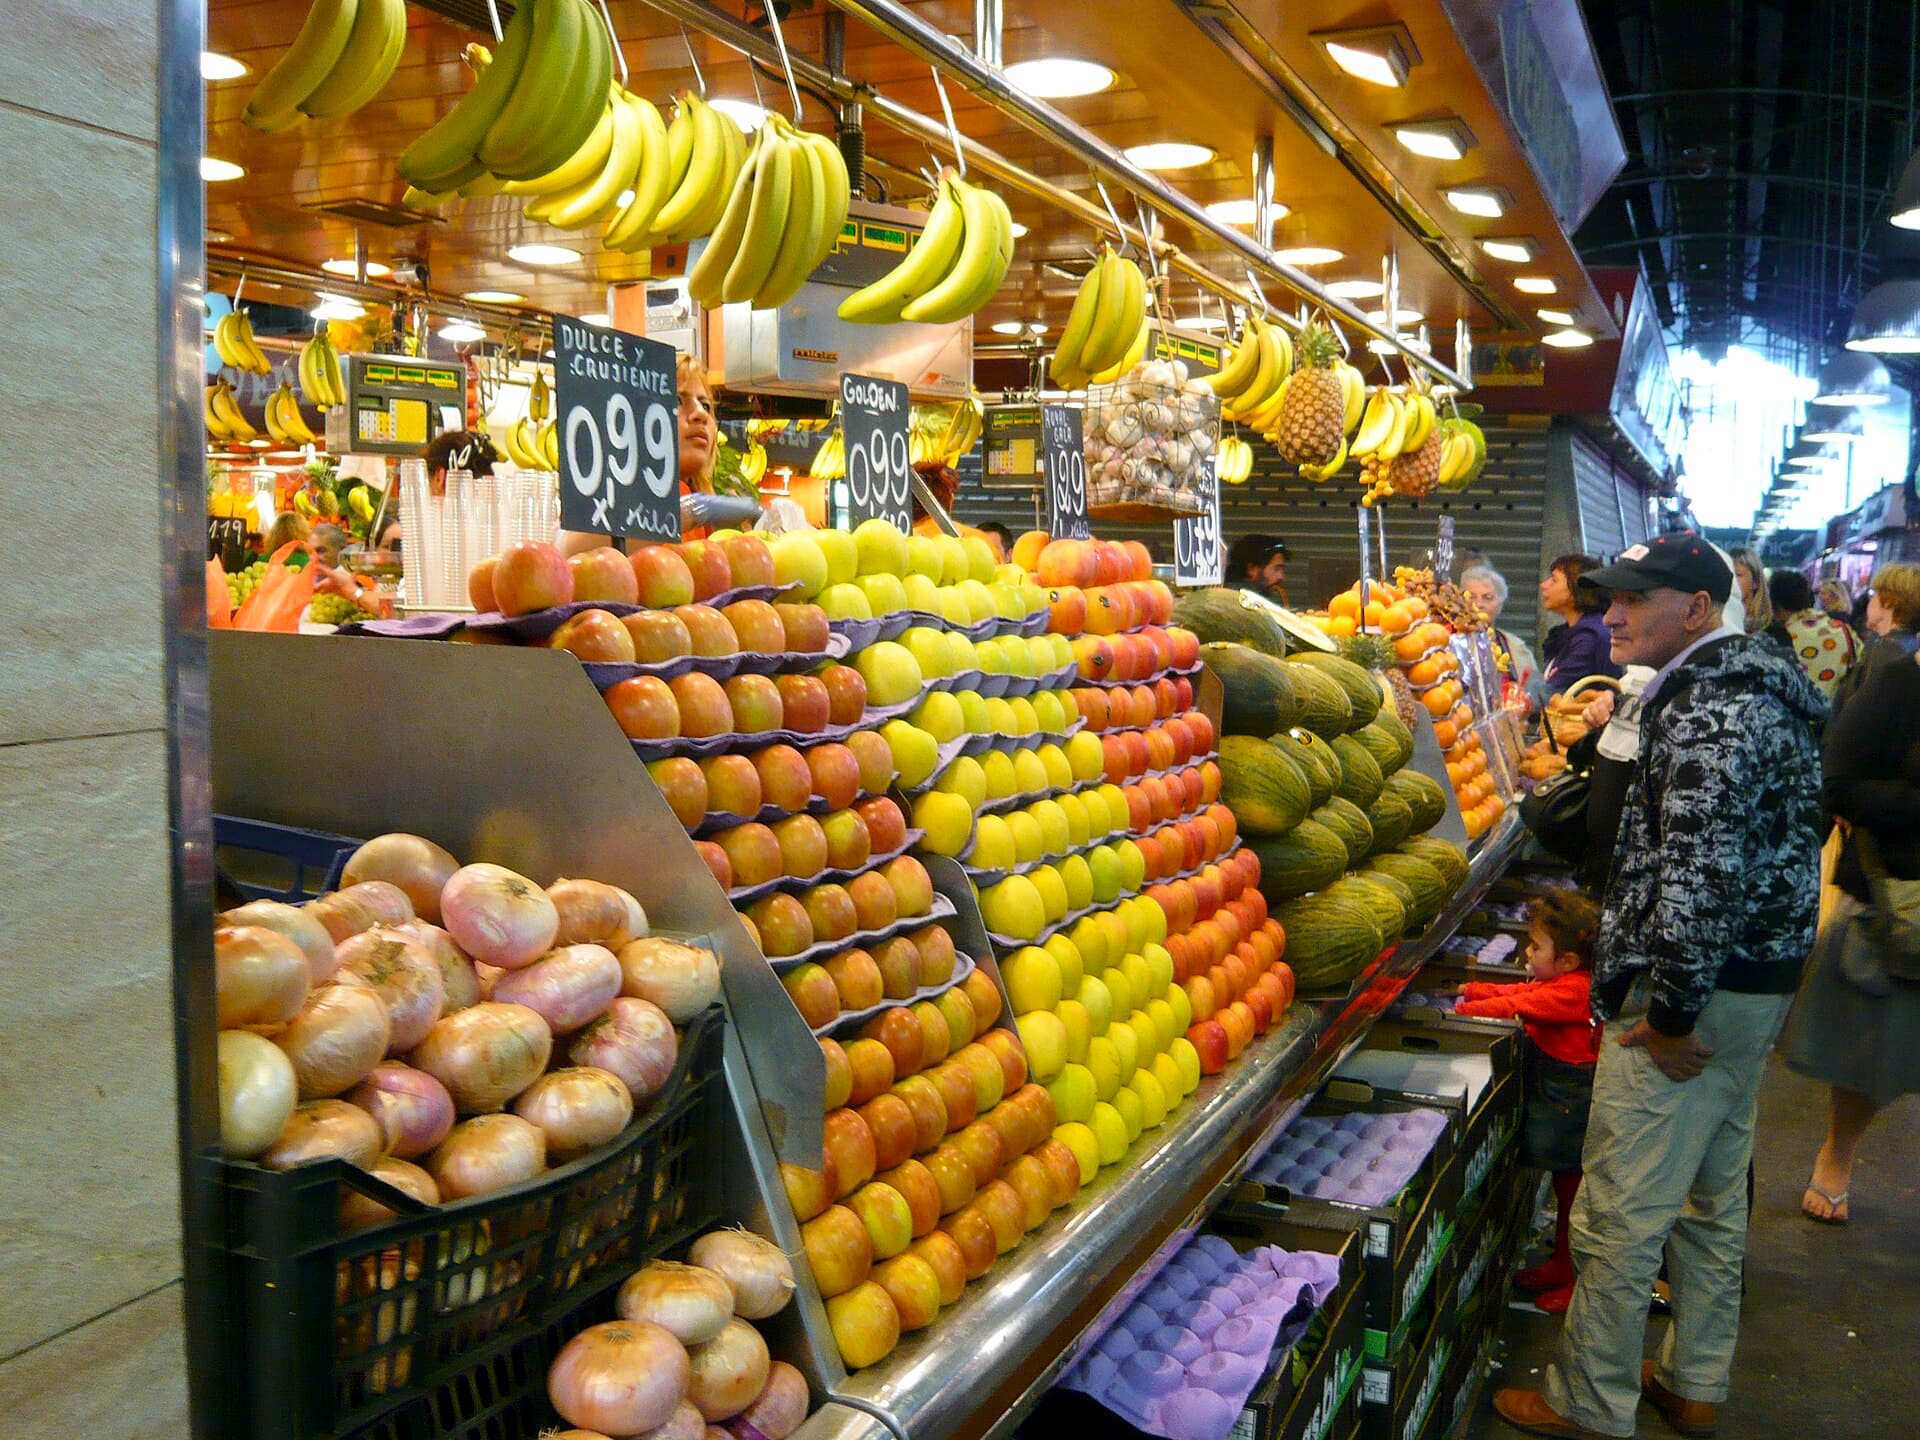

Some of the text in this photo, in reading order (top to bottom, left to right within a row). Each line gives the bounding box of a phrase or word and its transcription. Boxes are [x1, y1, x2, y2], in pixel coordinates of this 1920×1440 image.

[562, 324, 628, 362] DULCE
[573, 353, 672, 395] CRUJIENTE
[565, 393, 676, 509] 0,99
